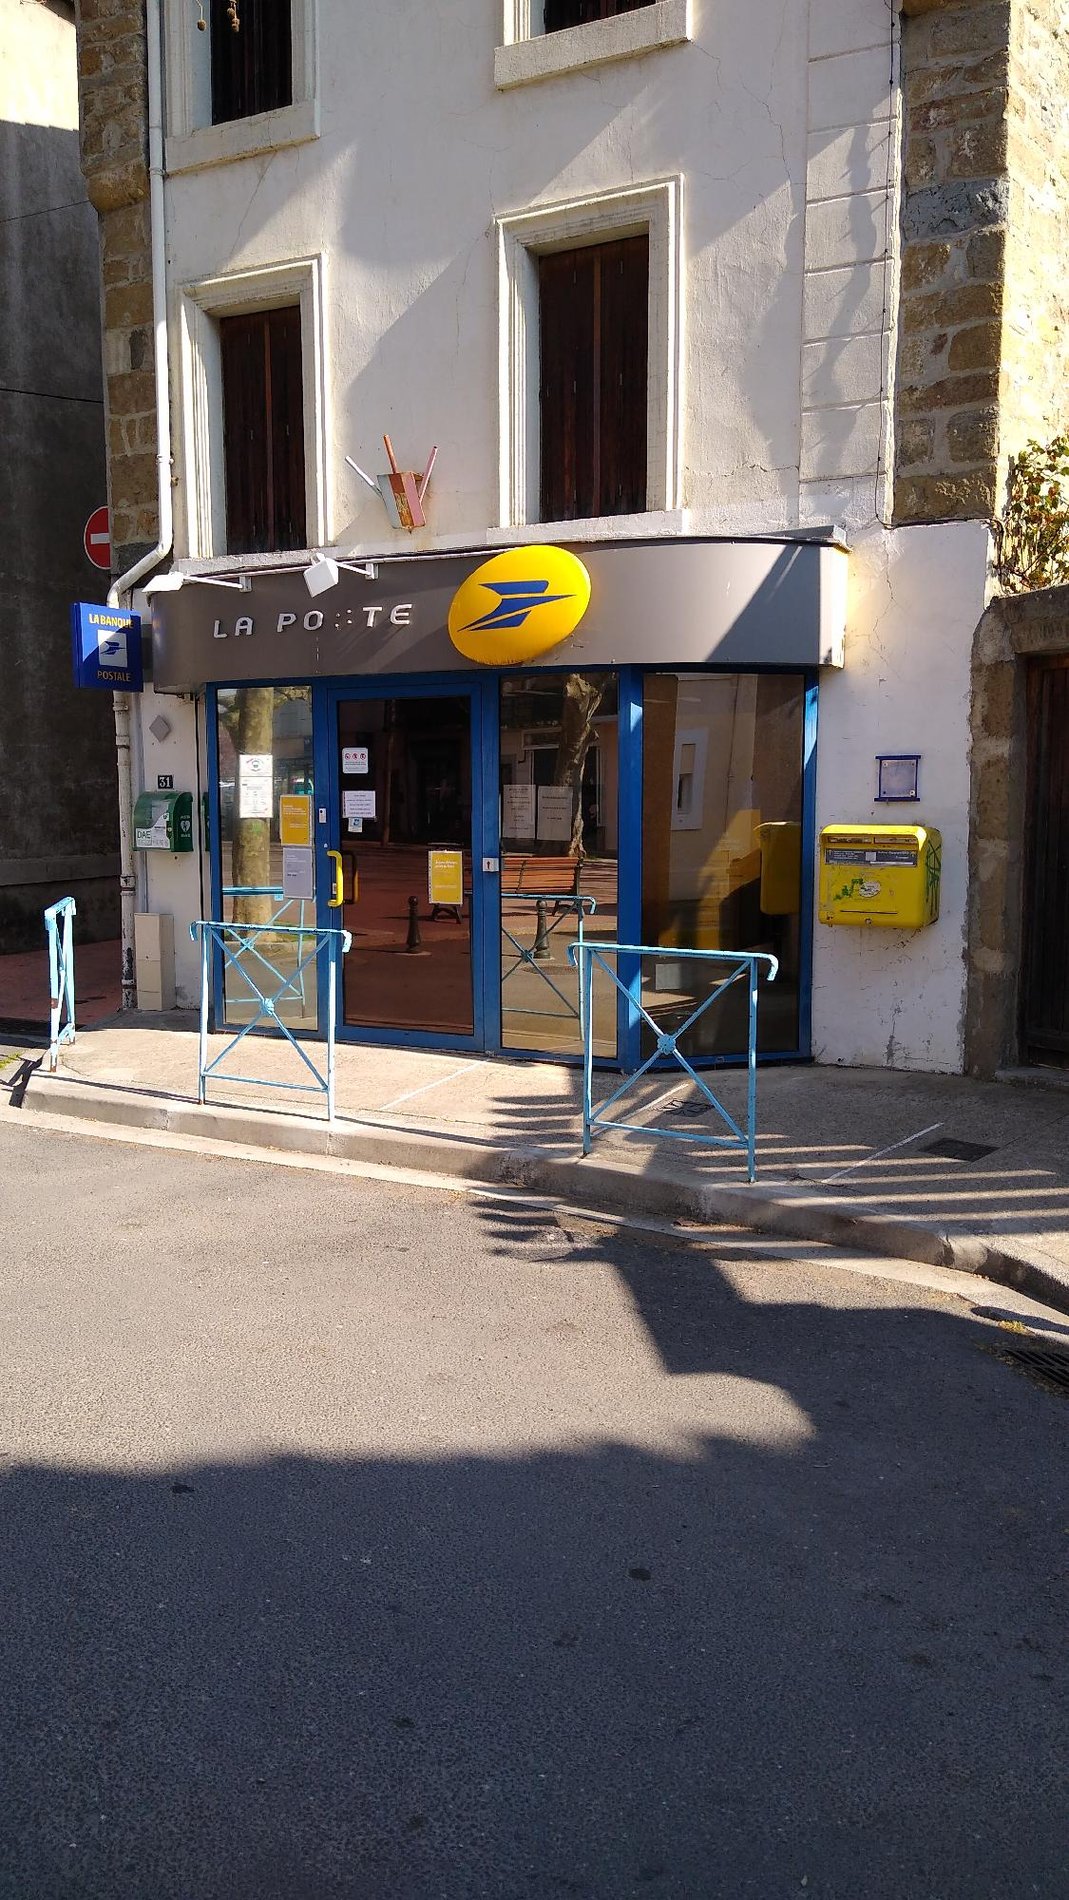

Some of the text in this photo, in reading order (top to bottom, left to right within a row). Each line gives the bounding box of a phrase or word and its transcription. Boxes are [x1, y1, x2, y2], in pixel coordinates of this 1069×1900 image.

[88, 613, 134, 629] LA BANQUE
[213, 603, 413, 639] LA POTE
[97, 670, 132, 682] POSTALE
[159, 776, 171, 788] 31
[137, 830, 151, 839] DAE
